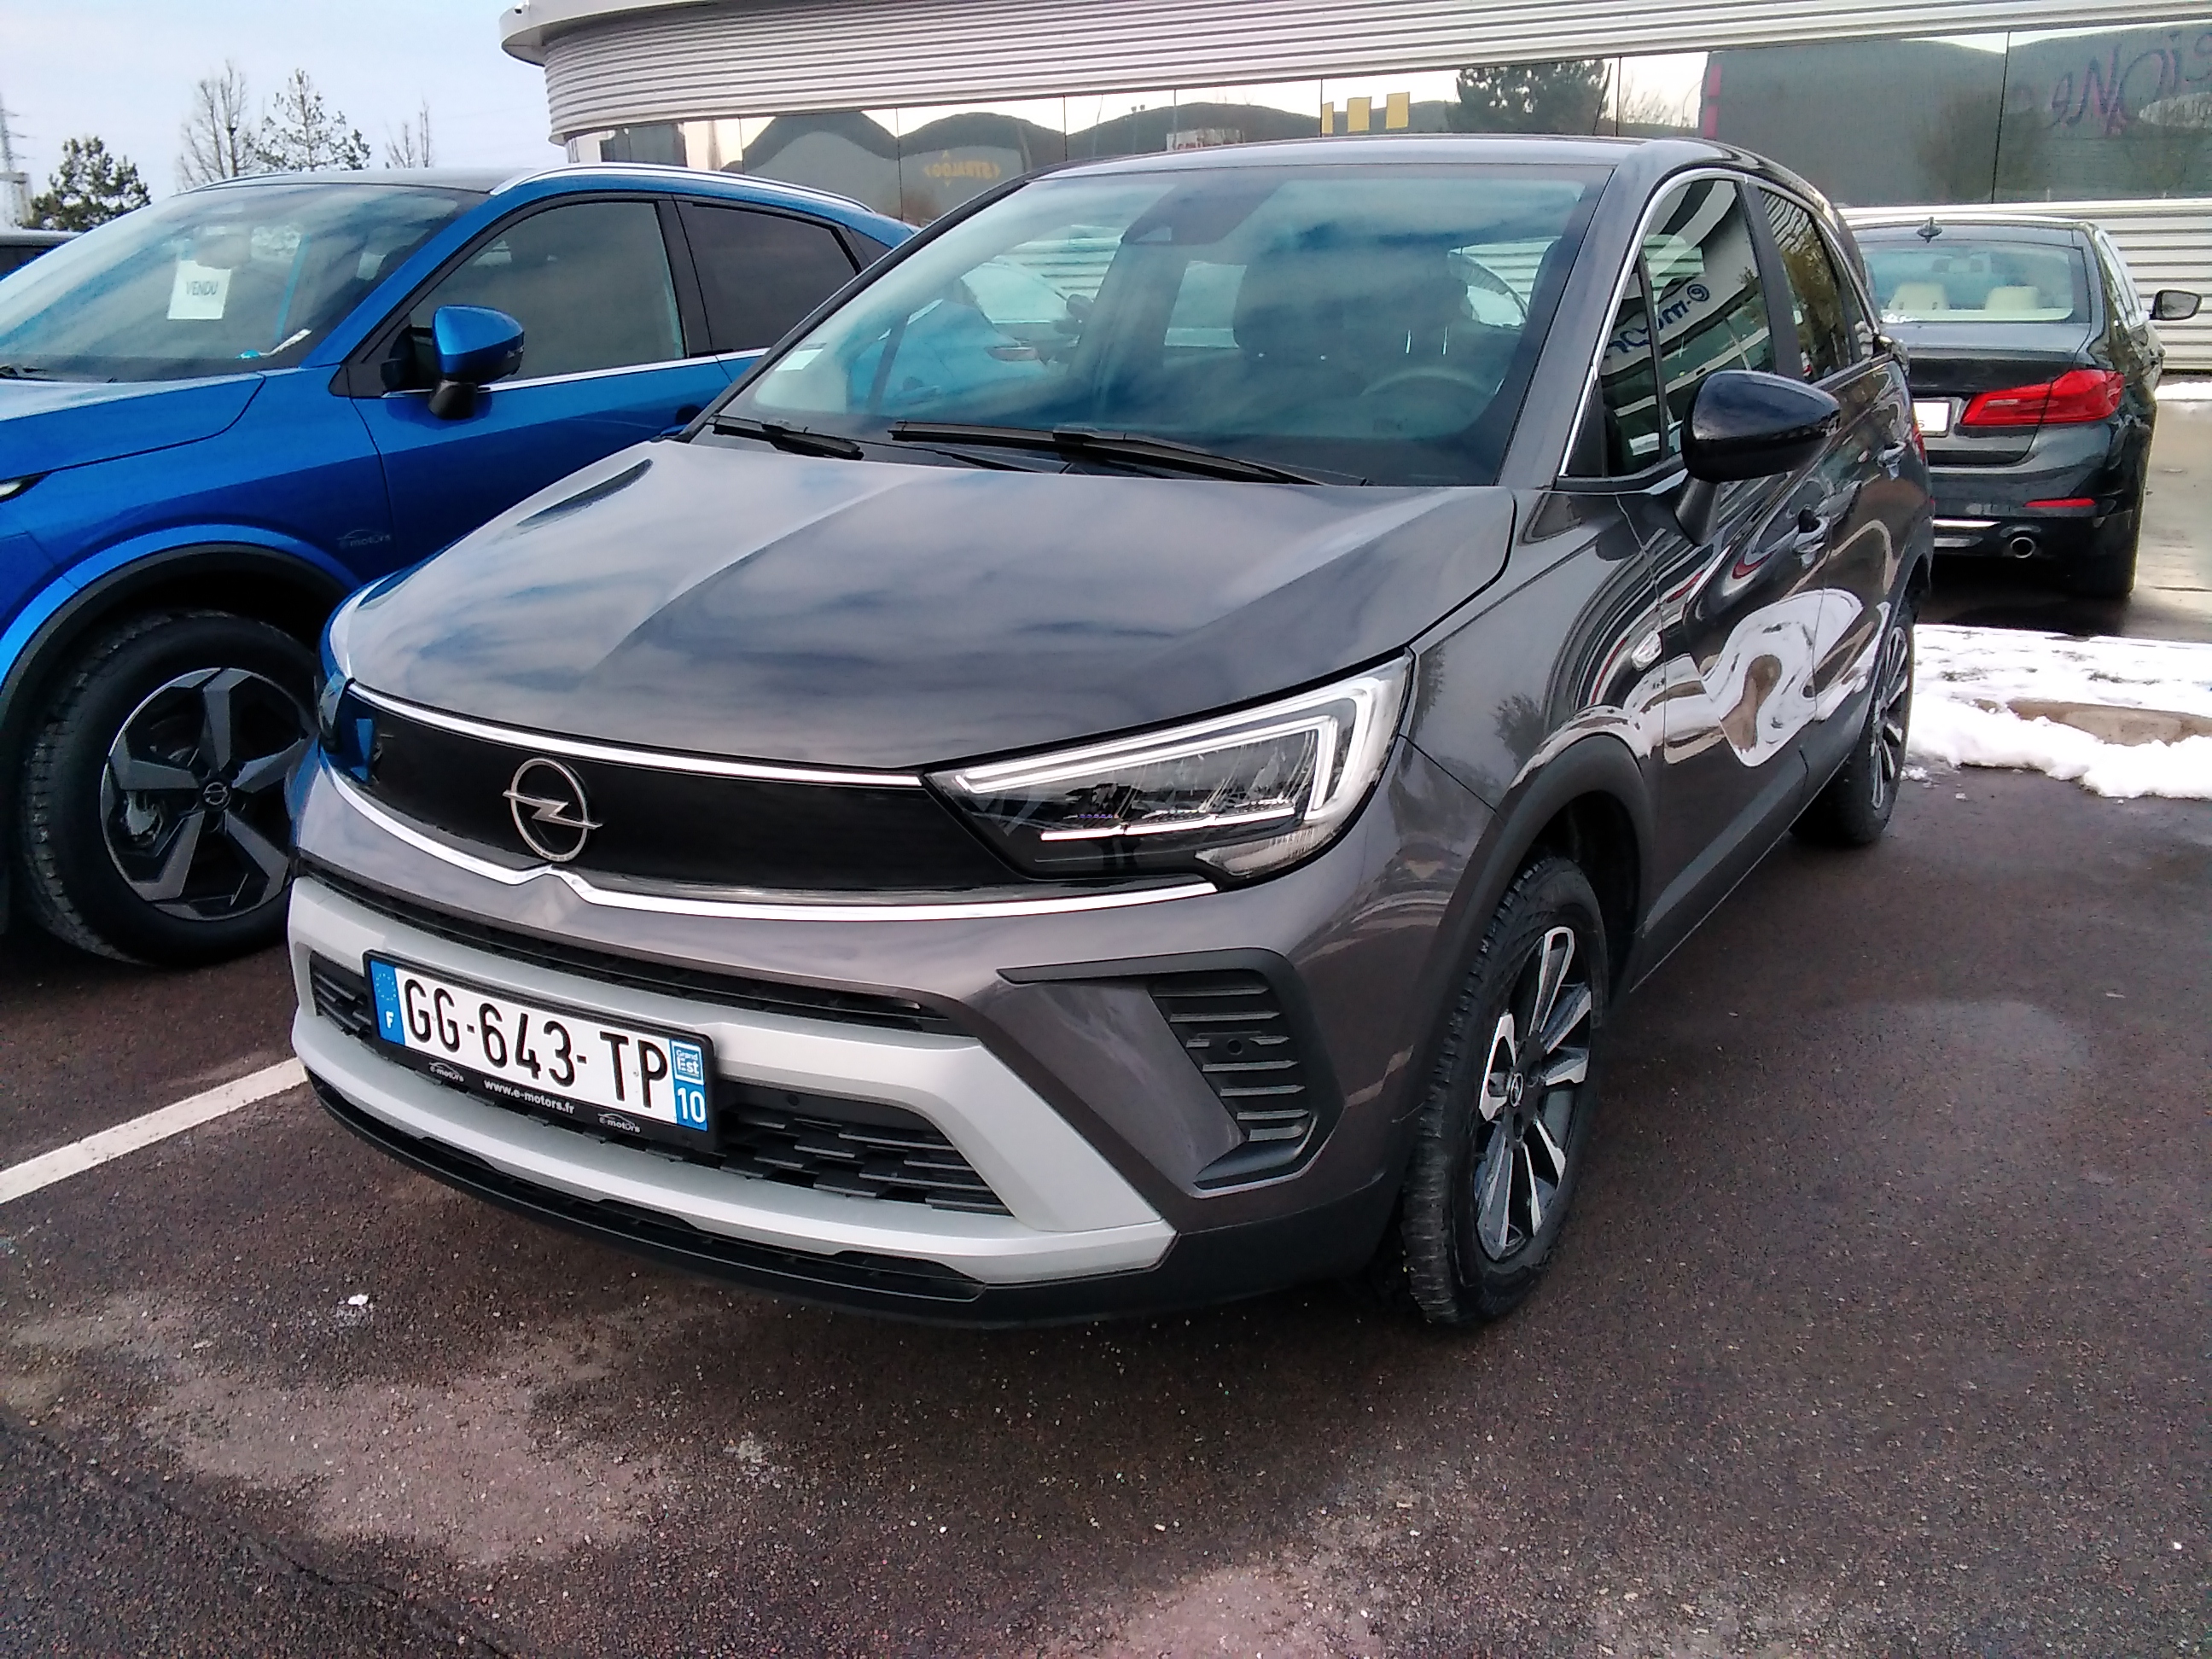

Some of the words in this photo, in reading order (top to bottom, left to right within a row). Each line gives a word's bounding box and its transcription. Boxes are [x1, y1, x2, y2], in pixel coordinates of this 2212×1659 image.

[385, 1010, 394, 1029] F
[404, 979, 668, 1109] GG-643-TP
[676, 1049, 698, 1061] Grand
[677, 1057, 699, 1074] Est
[483, 1080, 575, 1115] www.e-motors.fr
[677, 1087, 706, 1123] 10
